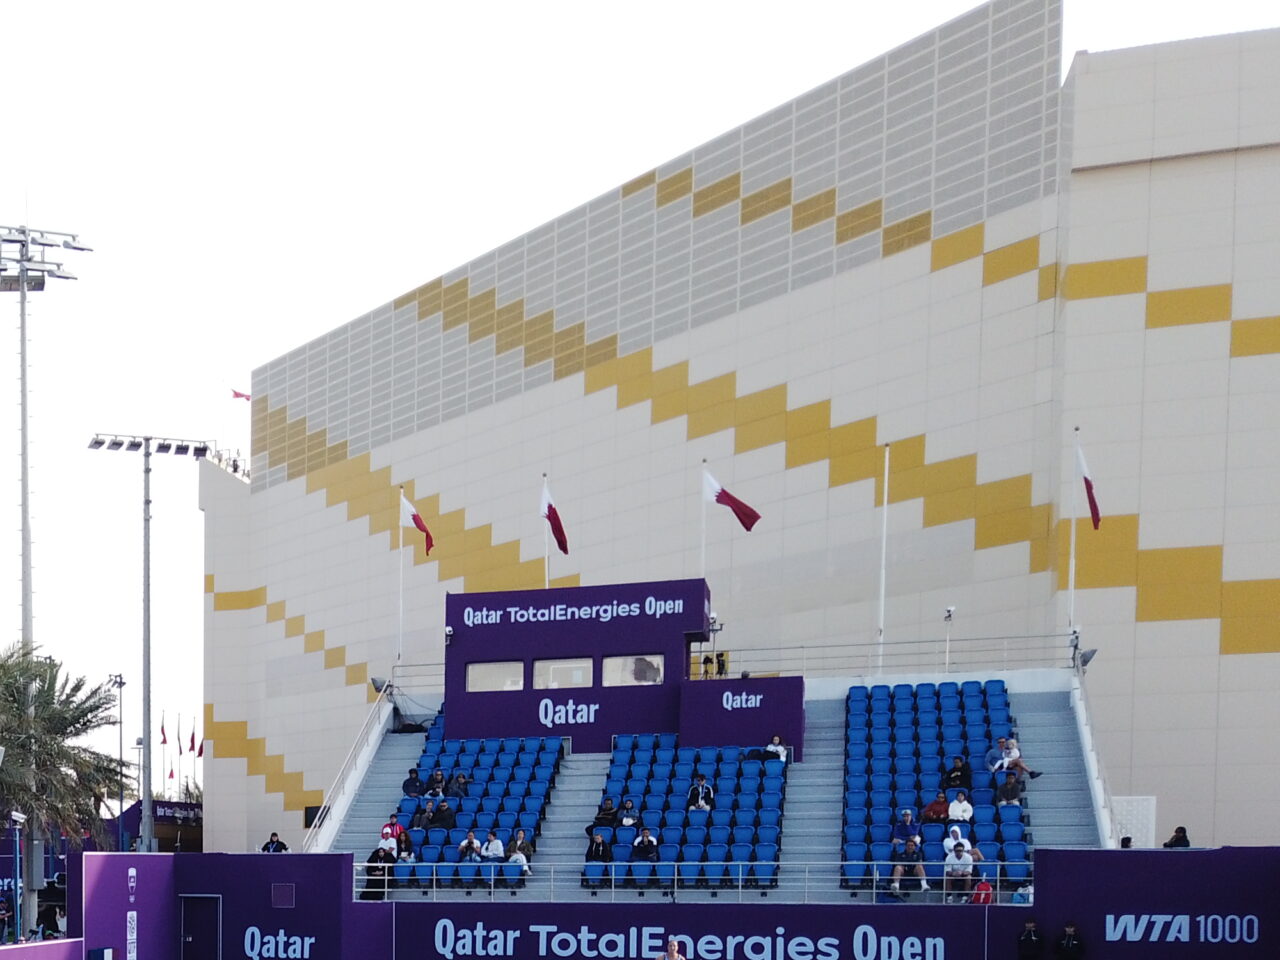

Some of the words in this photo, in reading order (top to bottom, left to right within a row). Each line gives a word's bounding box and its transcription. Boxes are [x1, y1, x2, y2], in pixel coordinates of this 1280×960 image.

[464, 606, 503, 627] Qatar
[507, 600, 640, 622] TotalEnergies
[644, 596, 684, 618] Open
[539, 698, 599, 728] Qatar
[722, 691, 764, 711] Qatar
[434, 918, 520, 960] Qatar
[1105, 914, 1190, 942] WTA
[1195, 914, 1259, 943] 1000
